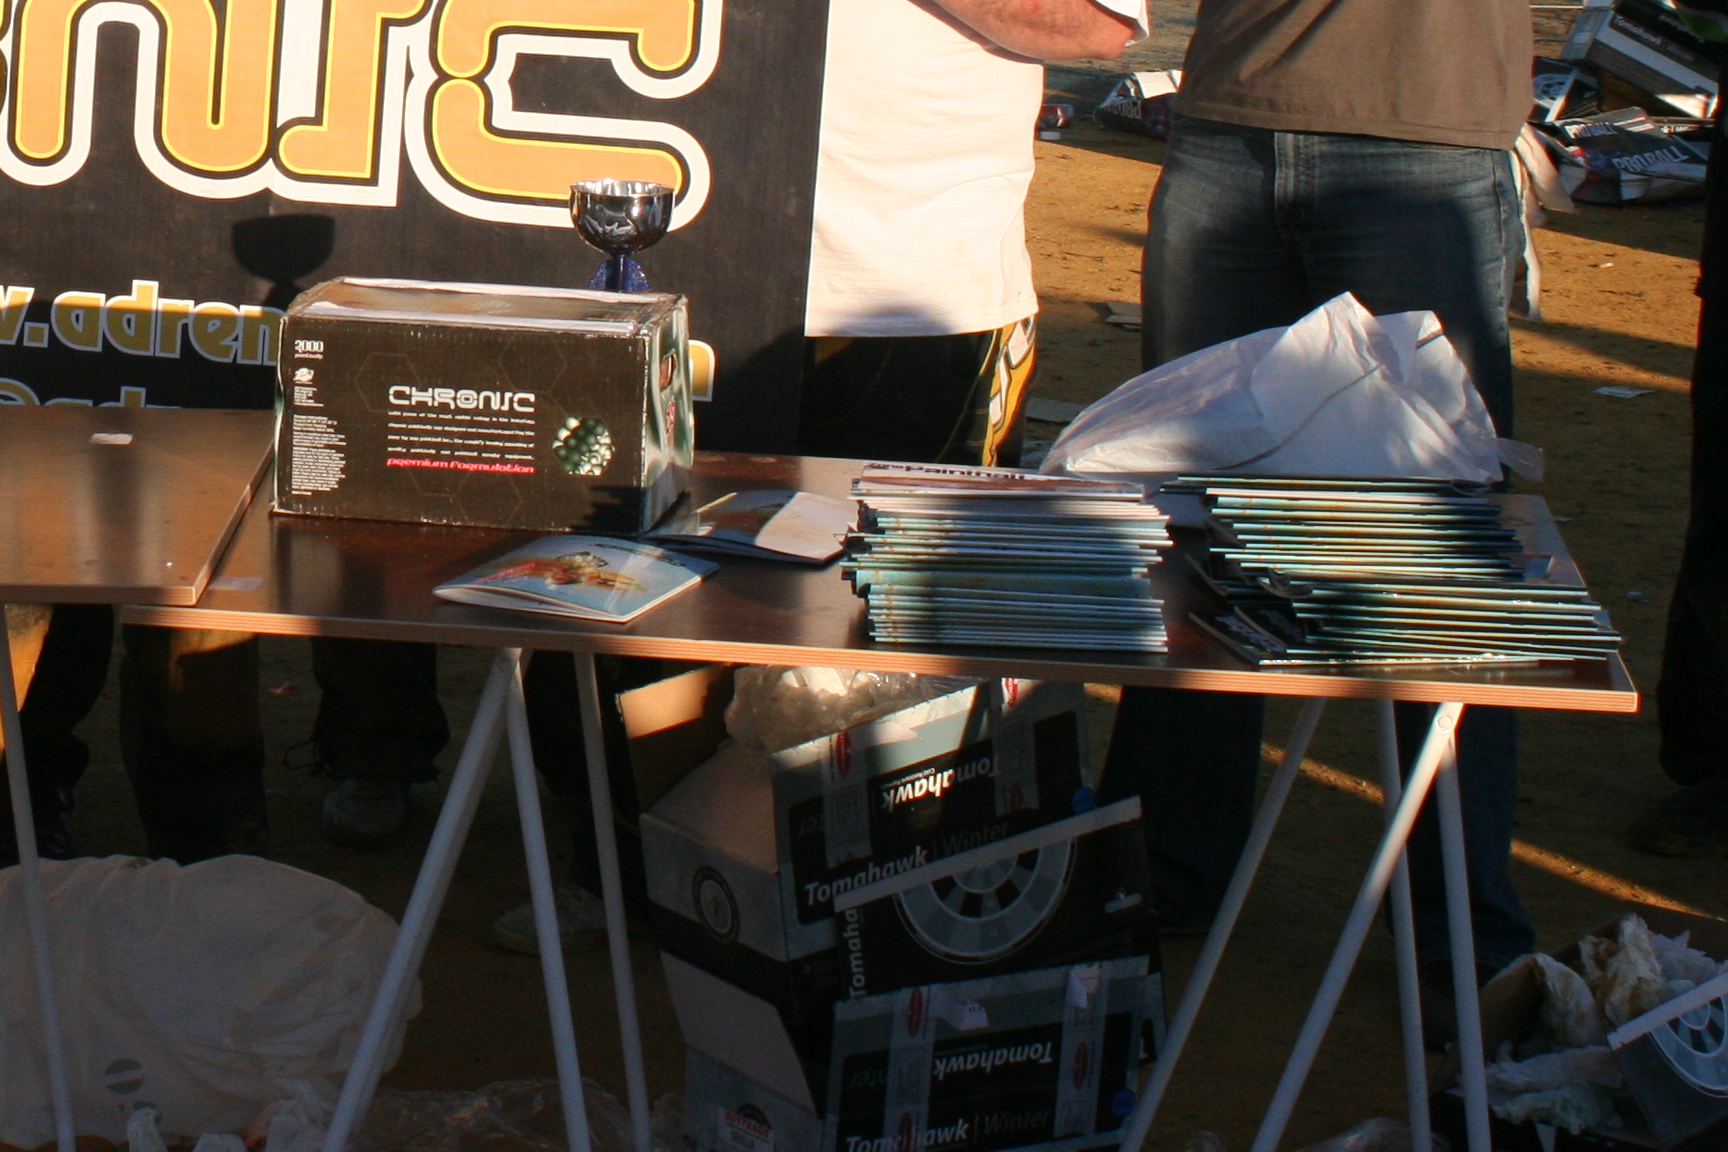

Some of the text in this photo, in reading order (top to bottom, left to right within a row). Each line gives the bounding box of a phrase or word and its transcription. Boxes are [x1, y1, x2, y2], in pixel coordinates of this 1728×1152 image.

[1613, 14, 1663, 45] Tomahawk
[1564, 121, 1618, 139] PROBALL
[1611, 145, 1690, 172] PROBALL
[388, 385, 536, 413] CHRONIC
[804, 845, 928, 907] Tomahawk
[841, 908, 867, 999] Tomaha
[933, 1041, 1054, 1081] Tomahawk
